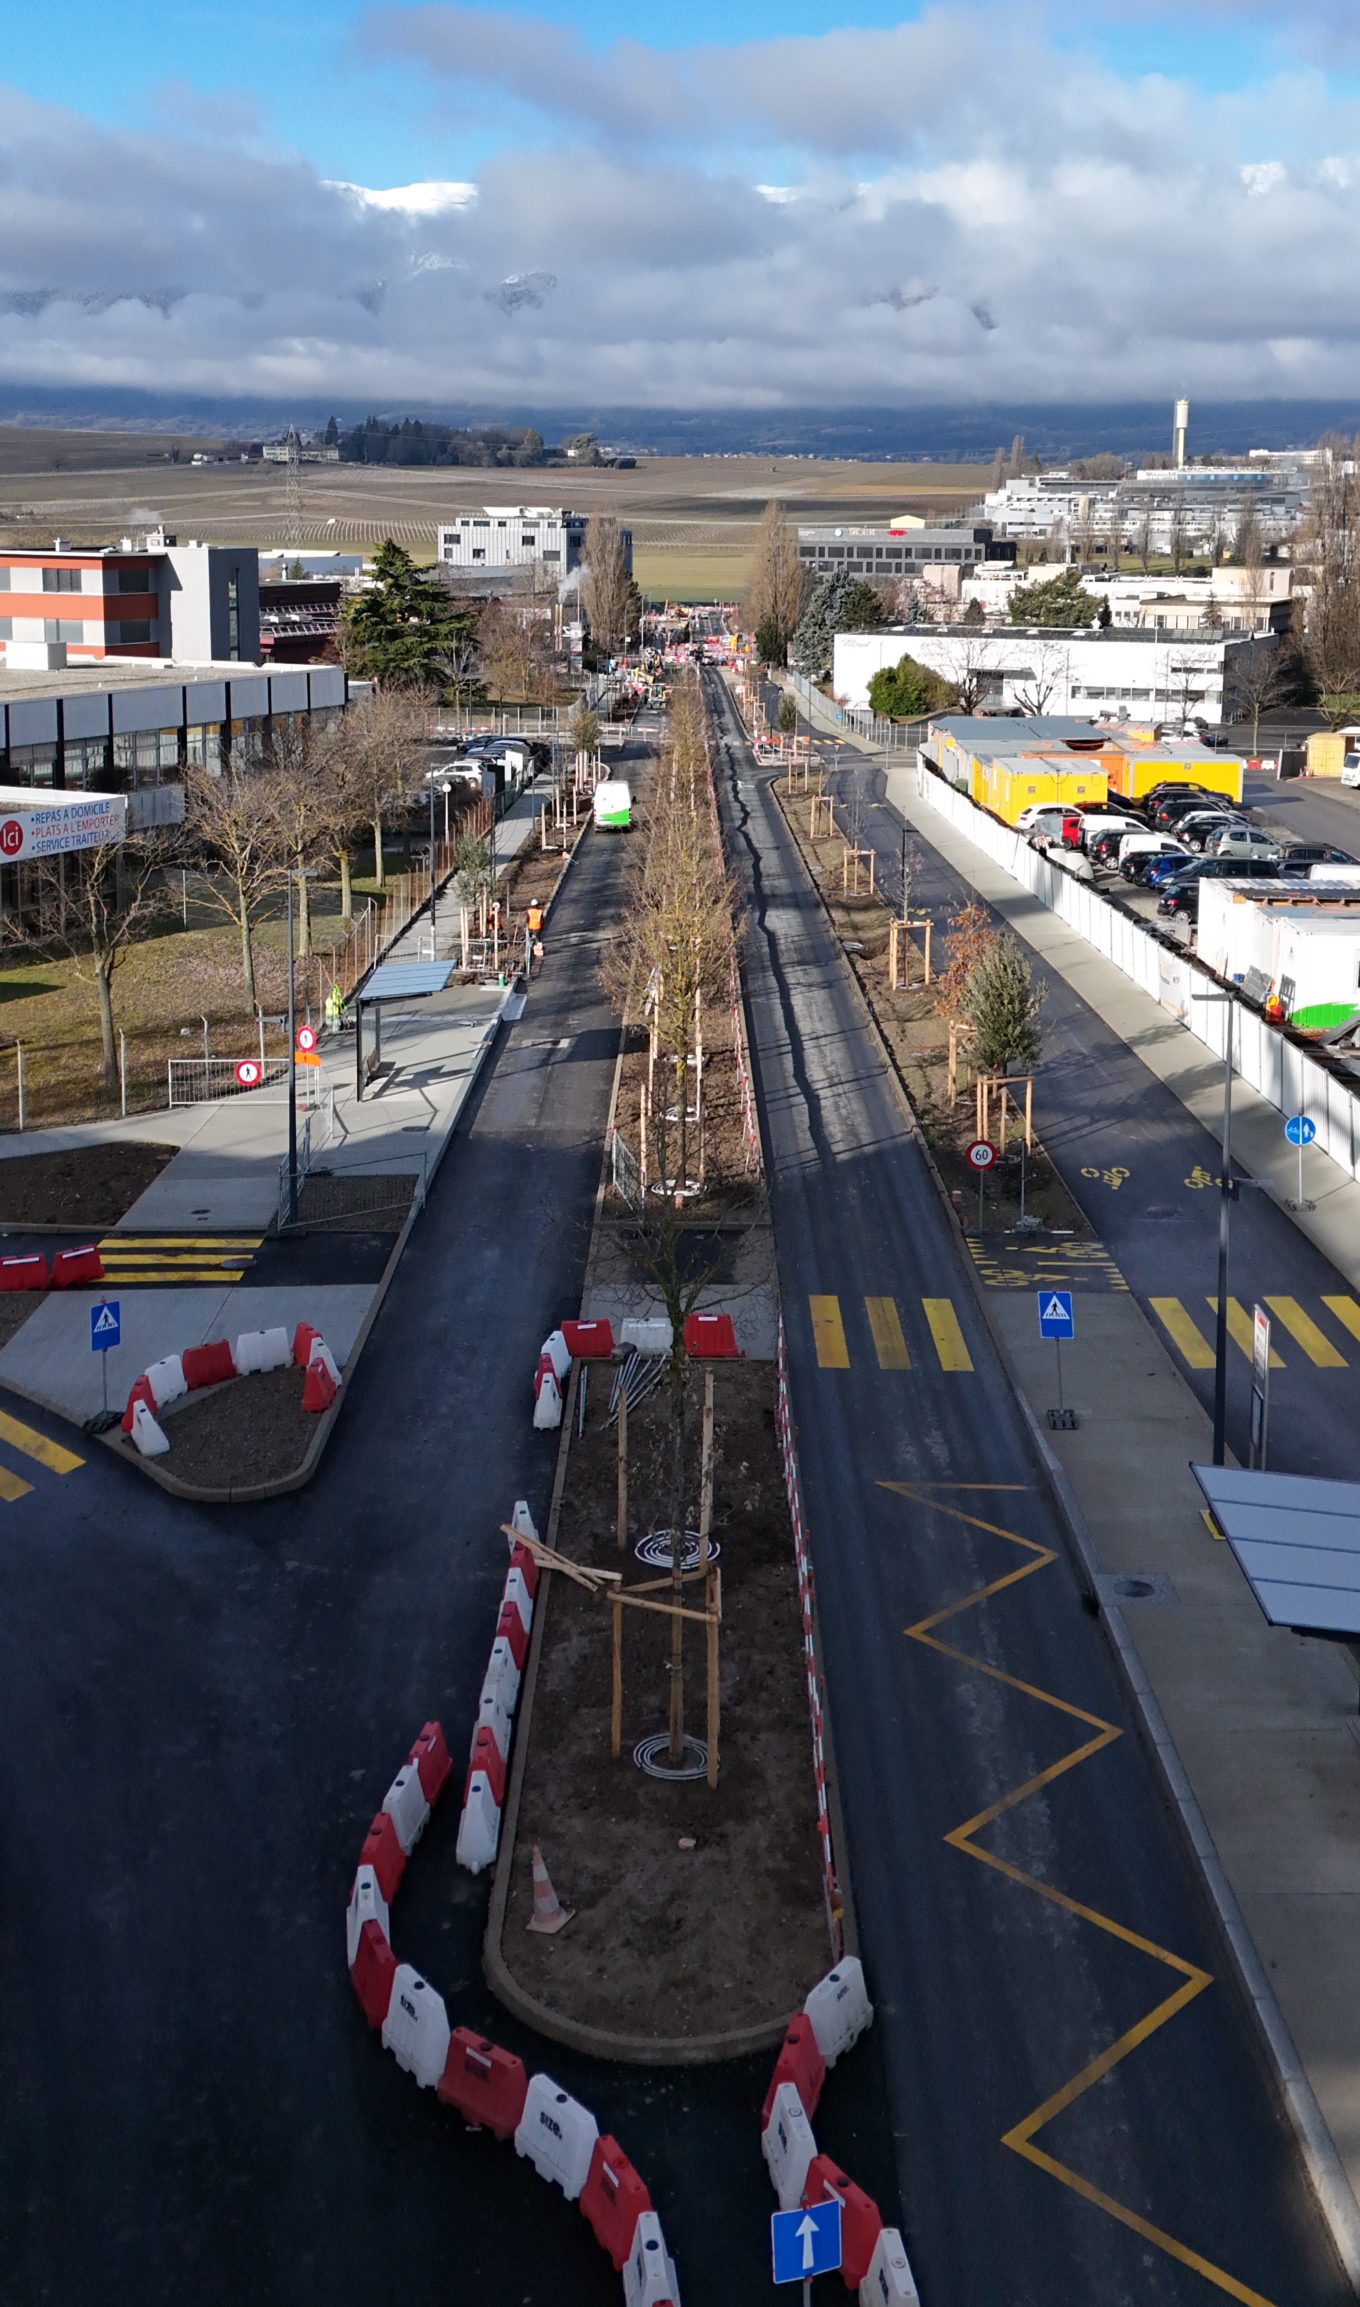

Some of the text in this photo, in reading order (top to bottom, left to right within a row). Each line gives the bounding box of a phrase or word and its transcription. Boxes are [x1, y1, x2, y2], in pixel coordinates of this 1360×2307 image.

[36, 802, 110, 825] REPAS A DOMICILE
[3, 827, 19, 848] Ici
[36, 825, 61, 839] PLATS
[63, 822, 69, 834] A
[36, 839, 70, 853] SERVICE
[976, 1150, 988, 1160] 60
